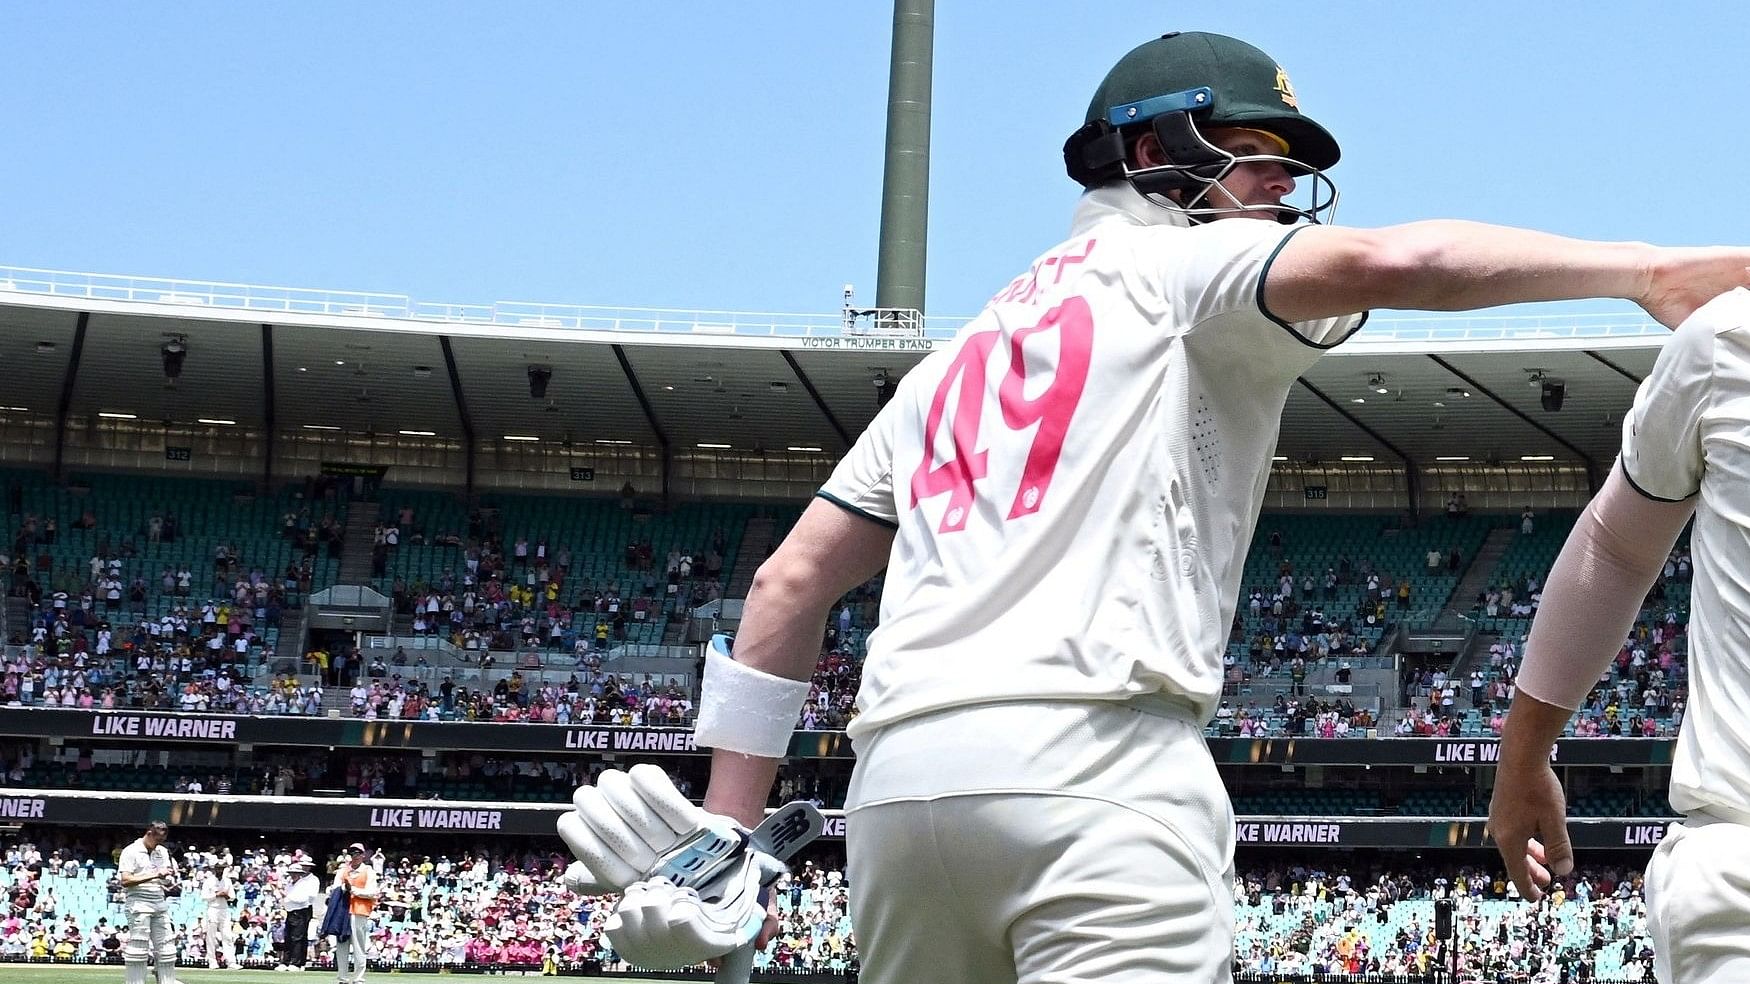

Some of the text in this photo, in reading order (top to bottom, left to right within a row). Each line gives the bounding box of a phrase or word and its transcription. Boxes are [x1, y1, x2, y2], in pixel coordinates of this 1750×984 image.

[802, 338, 933, 350] VICTOR TRUMPER STAND
[910, 295, 1095, 535] 49
[92, 716, 236, 738] LIKE WARNER
[565, 730, 697, 750] LIKE WARNER
[1435, 744, 1476, 762] LIKE
[0, 798, 46, 818] NER
[370, 808, 502, 830] LIKE WARNER
[1264, 824, 1340, 842] WARNER
[1624, 826, 1664, 844] LIKE
